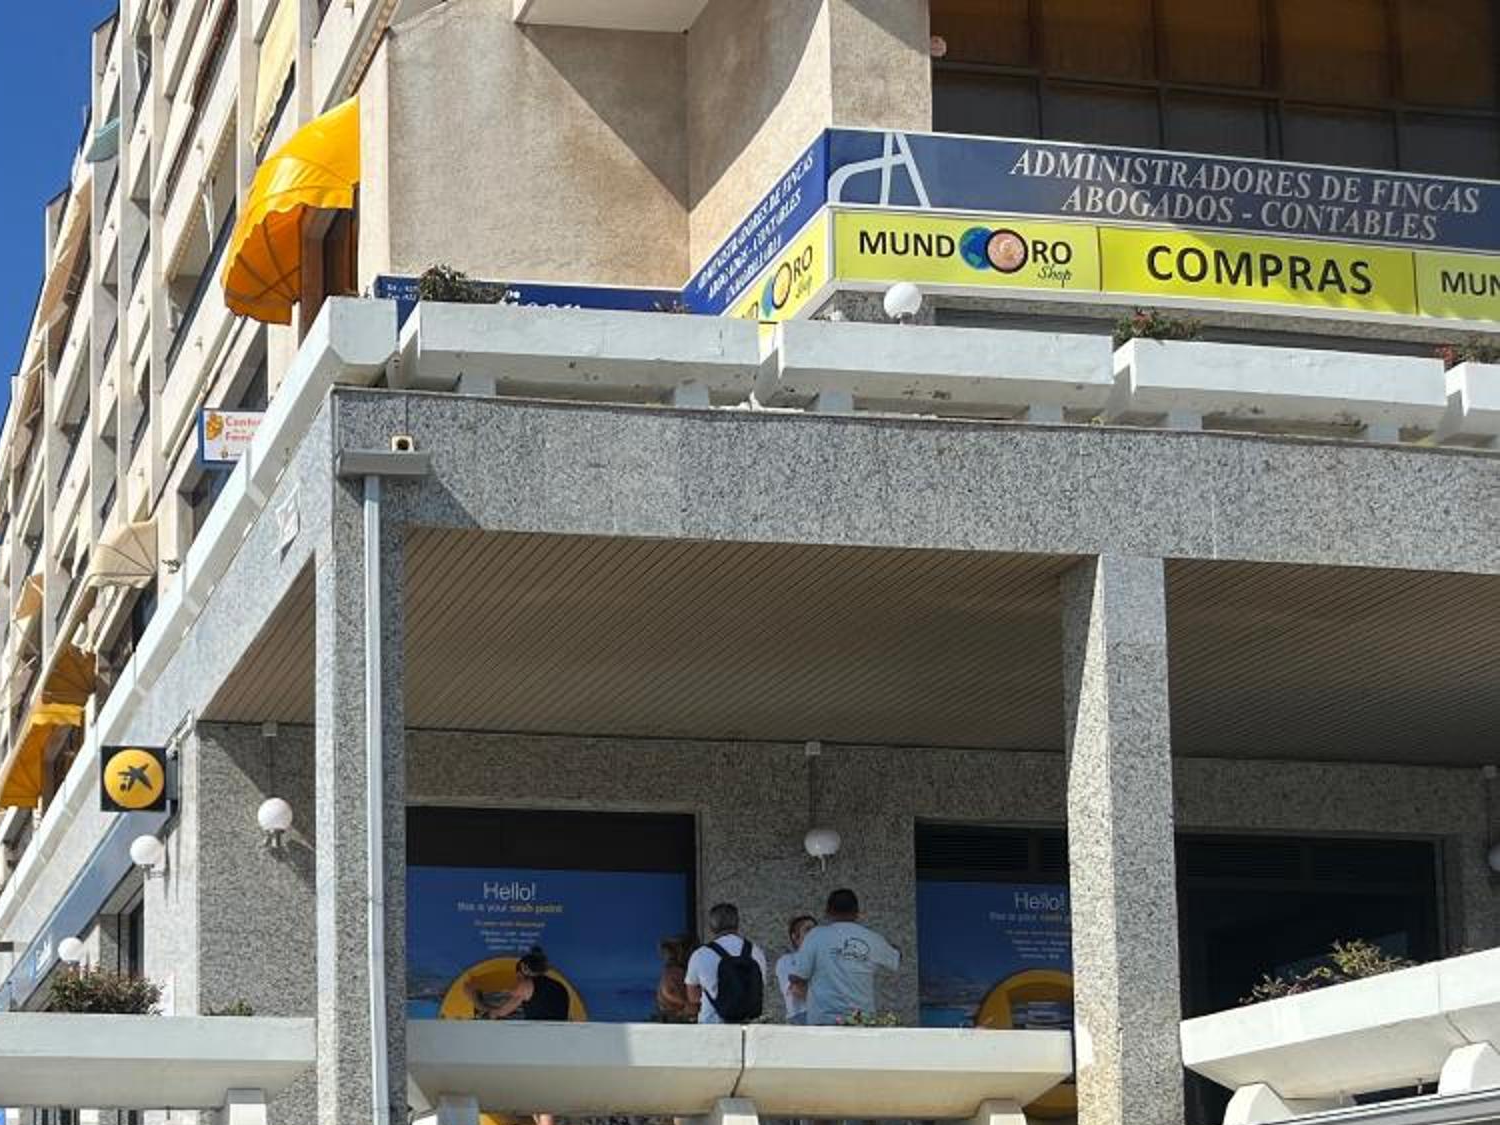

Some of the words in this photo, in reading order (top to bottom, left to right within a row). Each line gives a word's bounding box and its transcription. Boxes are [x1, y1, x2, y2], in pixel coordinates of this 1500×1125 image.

[1008, 148, 1311, 199] ADMINISTRADORES
[1321, 175, 1361, 202] DE
[1371, 179, 1480, 214] FINCAS
[1061, 186, 1235, 223] ABOGADOS
[1261, 200, 1438, 241] CONTABLES
[1146, 244, 1373, 296] COMPRAS
[483, 881, 536, 901] Hello!
